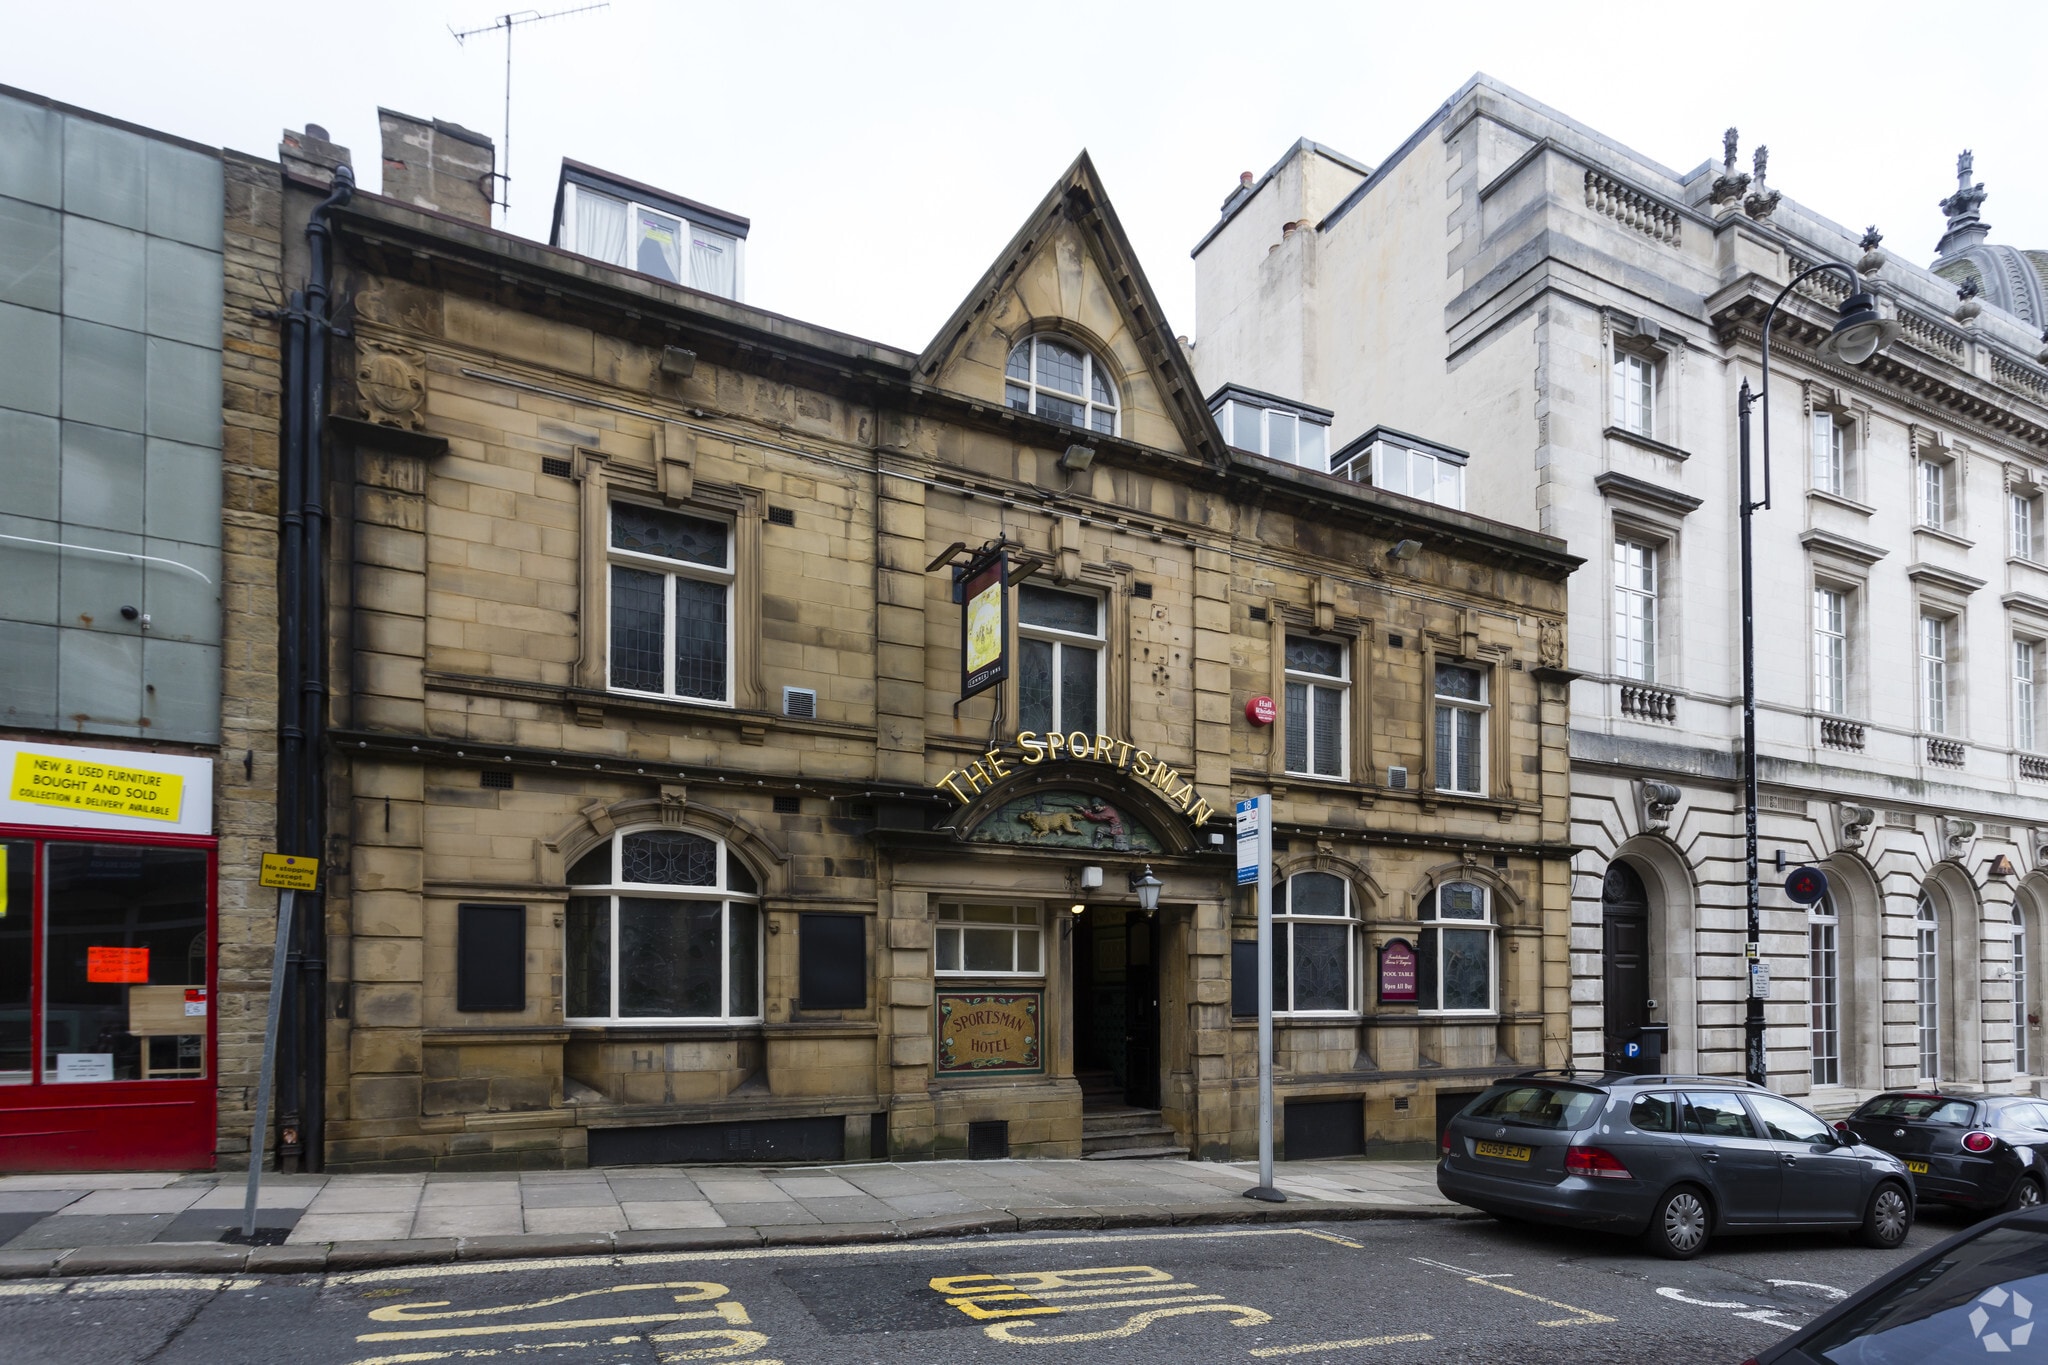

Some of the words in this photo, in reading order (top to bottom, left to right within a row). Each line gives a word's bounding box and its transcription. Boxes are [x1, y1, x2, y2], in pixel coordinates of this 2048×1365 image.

[1259, 700, 1272, 708] Hall
[34, 759, 61, 772] NEW
[65, 764, 73, 775] &
[78, 765, 104, 779] USED
[107, 770, 162, 787] FURNITURE
[936, 749, 1012, 805] THE
[1017, 731, 1215, 827] SPORTSMAN
[33, 774, 88, 791] BOUGHT
[92, 783, 121, 796] AND
[126, 787, 157, 801] SOLD
[19, 788, 71, 803] COLLECTION
[75, 796, 81, 804] &
[85, 797, 124, 810] DELIVERY
[128, 803, 170, 816] AVAILABLE
[1243, 800, 1252, 811] 18
[275, 873, 302, 881] except
[279, 866, 314, 875] stopping
[287, 880, 311, 888] buses
[1405, 983, 1413, 991] Day
[953, 1010, 1025, 1033] SPORTSMAN
[971, 1038, 1011, 1054] HOTEL
[1629, 1043, 1638, 1056] P
[1480, 1142, 1505, 1155] SG59
[1506, 1145, 1527, 1158] EJC
[928, 1265, 1273, 1345] BUS
